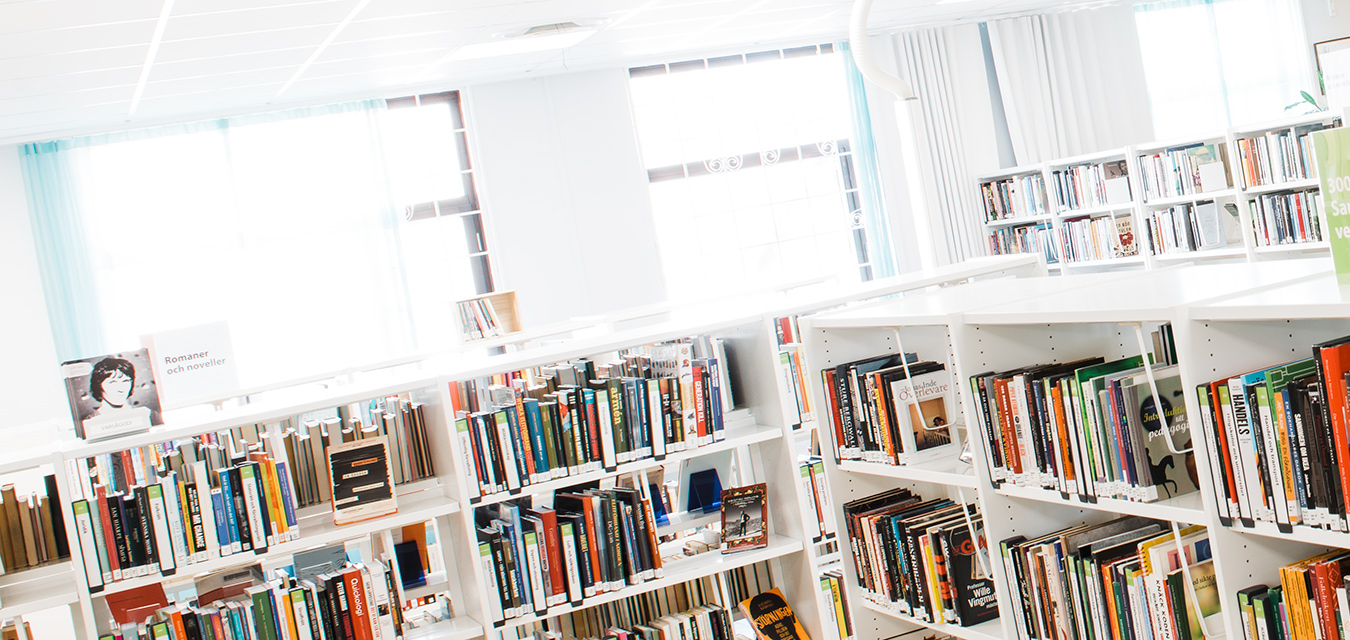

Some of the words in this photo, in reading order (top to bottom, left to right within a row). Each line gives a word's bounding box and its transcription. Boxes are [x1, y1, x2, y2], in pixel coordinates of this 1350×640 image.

[164, 350, 209, 364] Romaner
[166, 365, 186, 376] och
[187, 358, 226, 372] noveller
[691, 380, 706, 411] GENERATION
[839, 378, 848, 404] STURE
[899, 384, 949, 402] Överlevare
[516, 398, 524, 416] RYSKA
[608, 386, 625, 426] armén
[696, 411, 706, 423] KILL
[1232, 393, 1250, 436] HANDELS
[519, 416, 531, 452] ELITFÖRBAND
[1294, 413, 1306, 447] SANNINGEN
[461, 436, 469, 454] Offentlig
[590, 439, 602, 460] FRONT
[1226, 413, 1236, 447] Högskolor
[1234, 460, 1244, 497] universitet
[1264, 414, 1273, 439] Handel
[1271, 453, 1280, 487] transport
[1300, 447, 1307, 457] OM
[464, 454, 473, 477] förvaltning
[1301, 456, 1310, 471] IKEA
[154, 502, 162, 520] Folkrätt
[608, 498, 622, 538] ELITFÖRBAND
[80, 519, 88, 534] Juridik
[193, 524, 205, 548] CHANCE
[614, 542, 624, 567] NORDEN
[532, 569, 541, 590] utrustning
[349, 577, 364, 617] Quickologi
[973, 586, 990, 598] Wille
[1318, 576, 1330, 622] Folkdräkten
[753, 606, 793, 630] STÖRNINGEN
[1156, 579, 1165, 608] KNÄCK
[1161, 610, 1170, 639] KODEN
